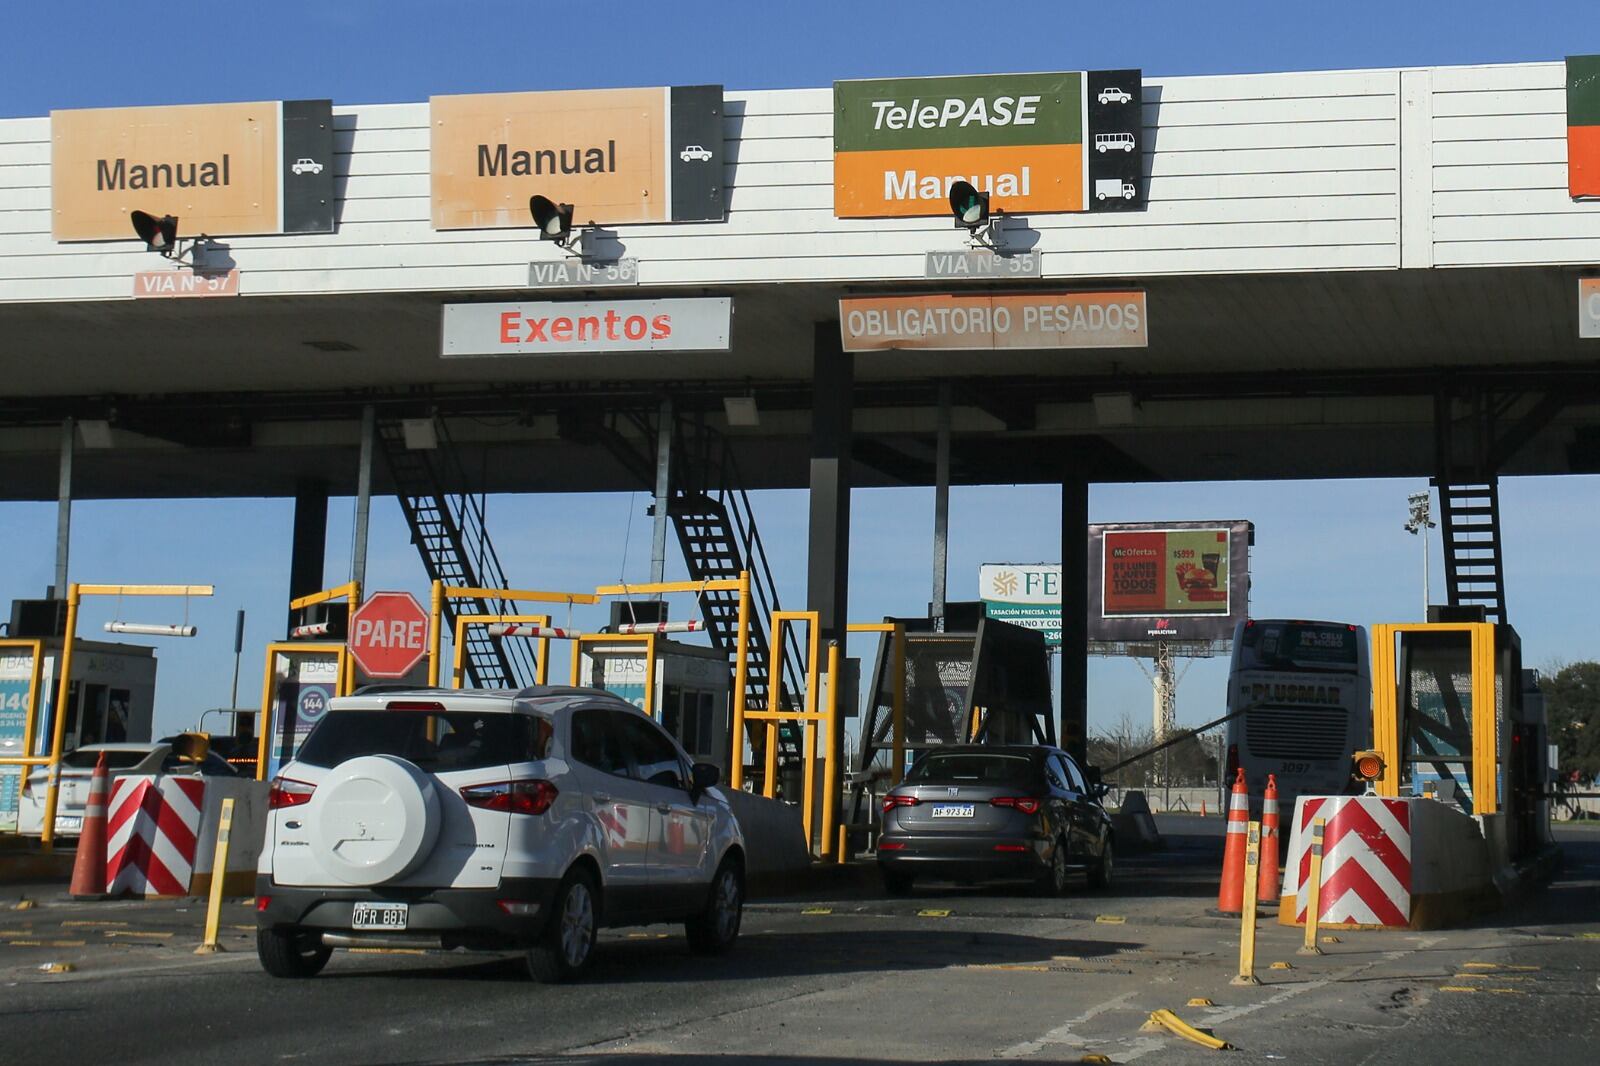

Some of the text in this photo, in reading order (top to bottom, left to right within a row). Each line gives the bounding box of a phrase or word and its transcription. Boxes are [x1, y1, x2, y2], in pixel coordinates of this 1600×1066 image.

[872, 95, 1041, 130] TelePASE
[477, 140, 616, 177] Manual
[96, 154, 230, 191] Manual
[534, 264, 569, 282] VIA
[607, 262, 631, 280] 56
[932, 255, 969, 274] VIA
[1009, 254, 1034, 273] 55
[143, 275, 175, 292] VIA
[208, 274, 231, 291] 57
[500, 309, 672, 344] Exentos
[848, 303, 1140, 337] OBLIGATORIO PESADOS
[1113, 548, 1157, 557] McOfertas
[1113, 579, 1157, 590] TODOS
[354, 619, 423, 649] PARE
[303, 698, 323, 710] 144
[1251, 684, 1340, 704] PLUSMAR
[1280, 762, 1311, 773] 3097
[934, 808, 972, 816] AF 973 ZA
[355, 909, 404, 924] OFR 881
